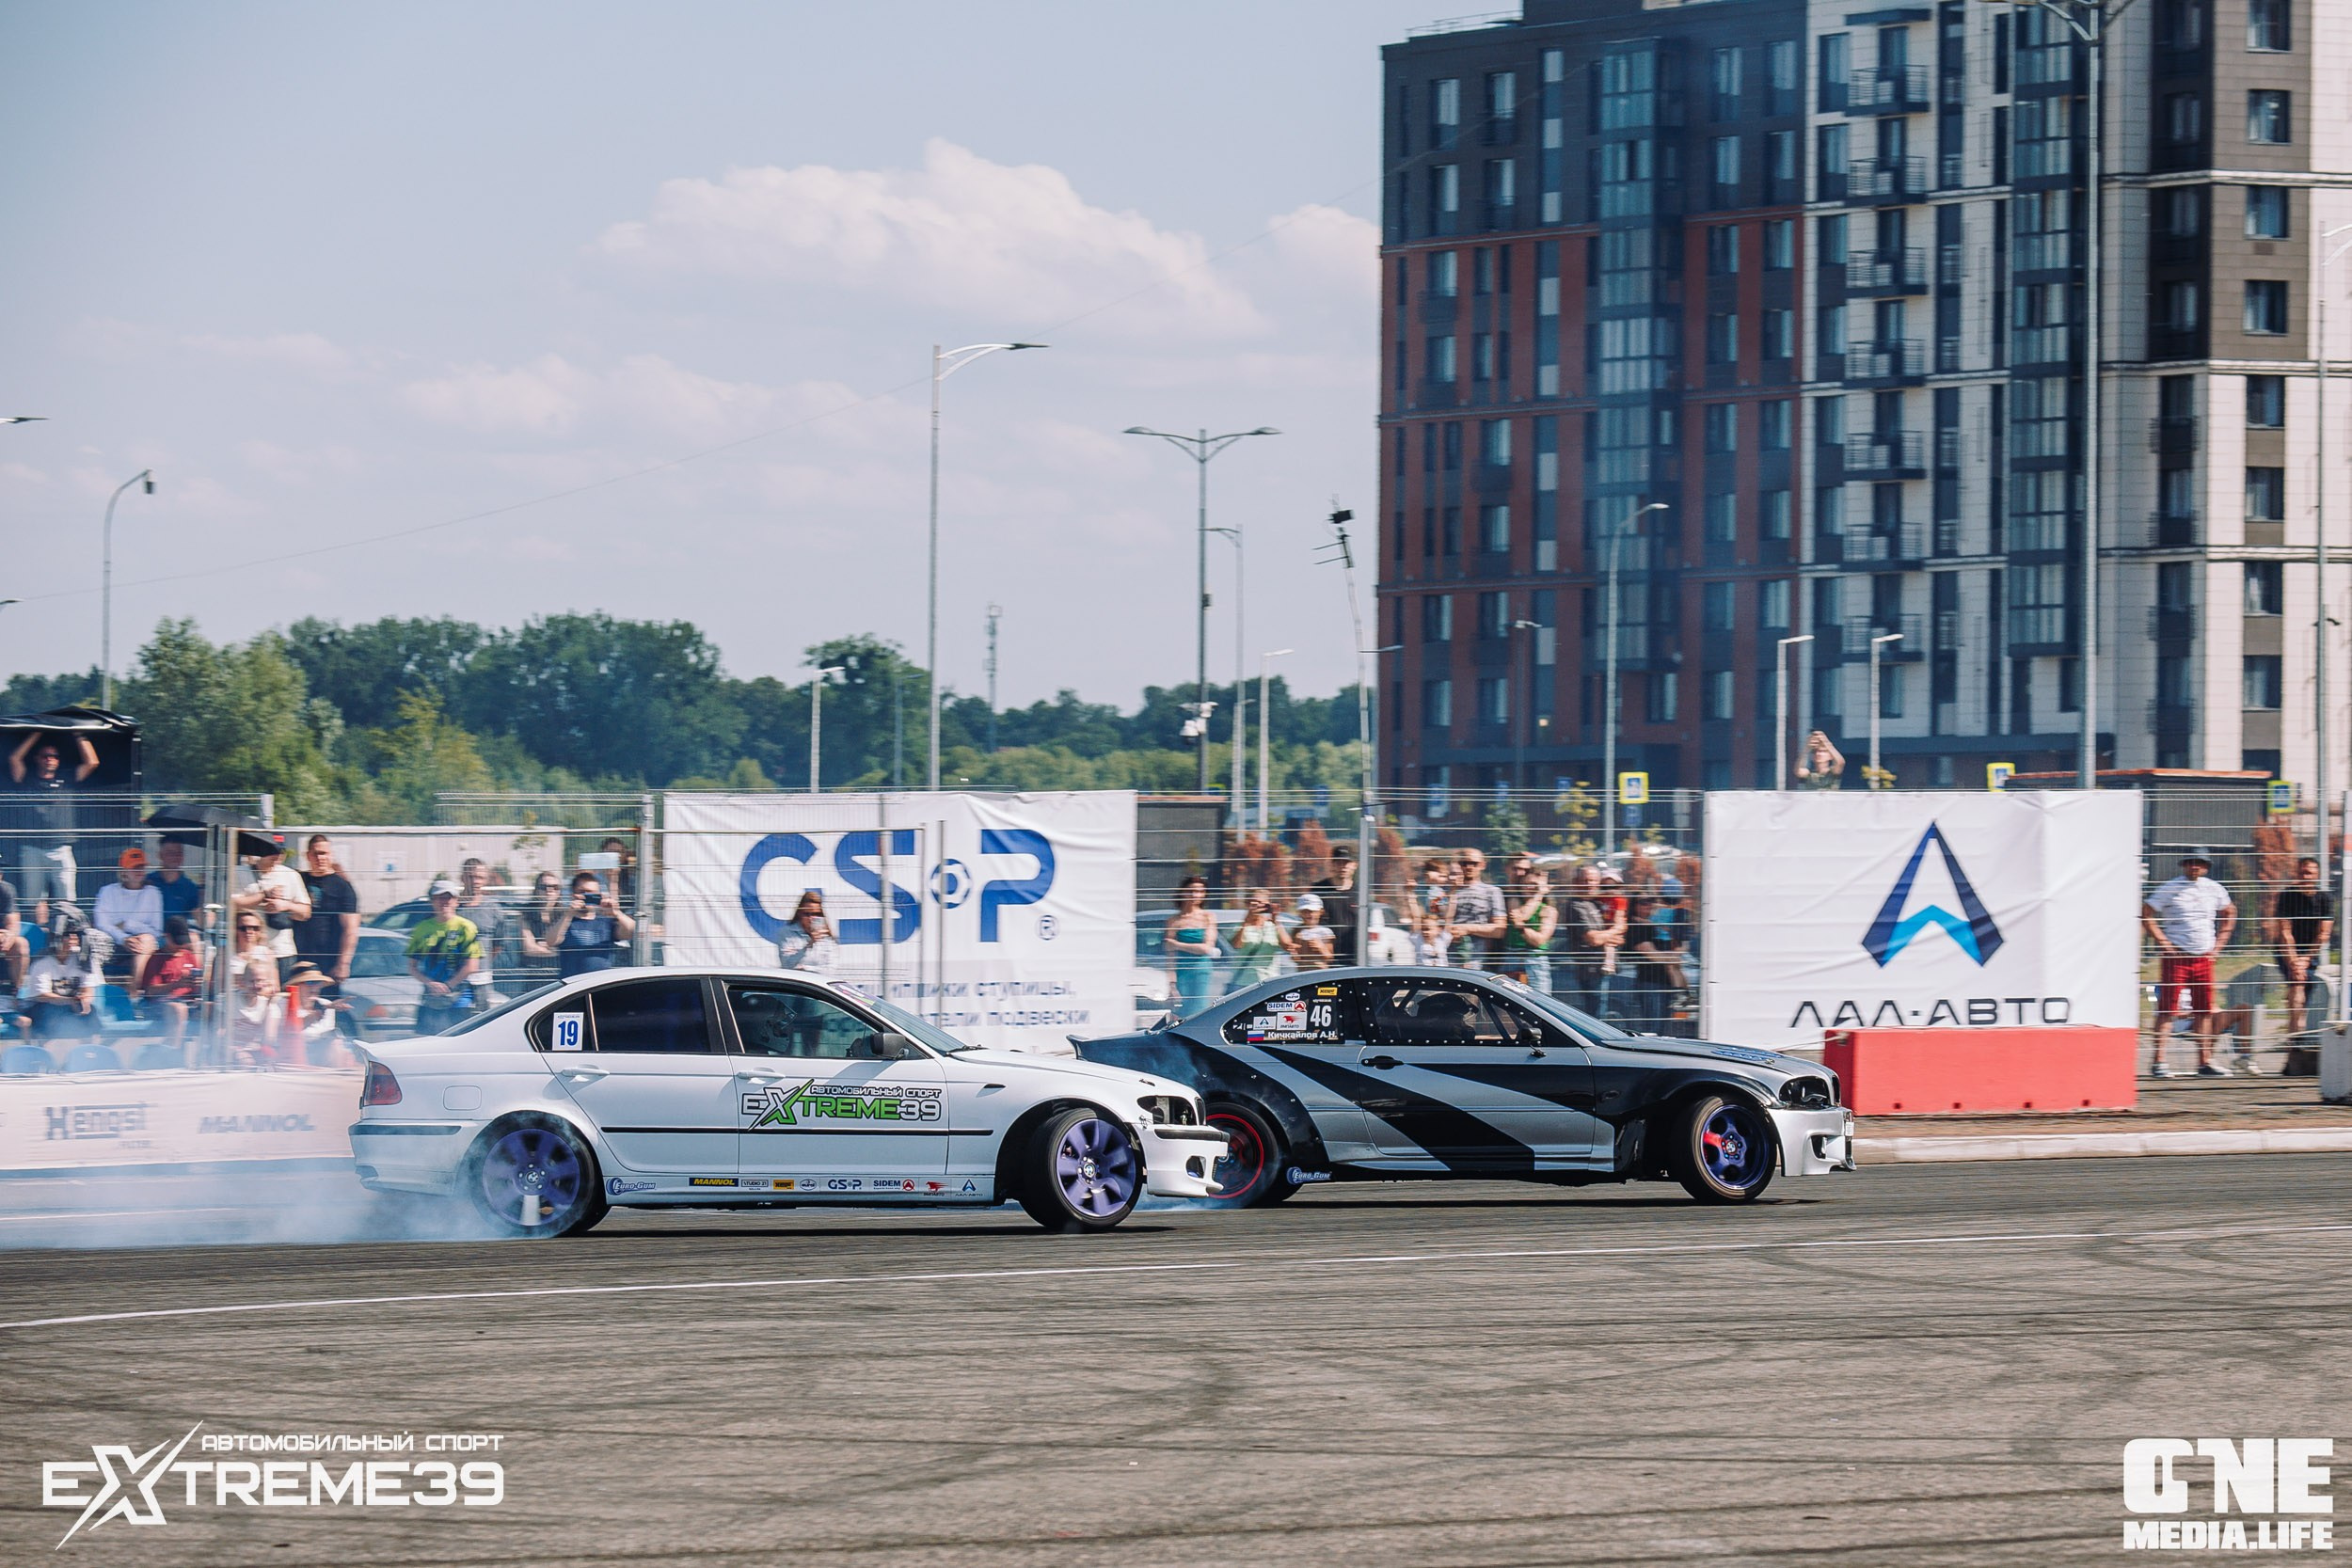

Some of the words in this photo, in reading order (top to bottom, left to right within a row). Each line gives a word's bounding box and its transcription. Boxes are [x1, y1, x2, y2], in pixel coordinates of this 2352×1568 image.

[1310, 1005, 1332, 1027] 46
[558, 1021, 579, 1046] 19
[1319, 1030, 1338, 1039] А.Н.
[810, 1085, 903, 1098] АВТОМОБИЛЬНЫЙ
[905, 1087, 942, 1099] СПОРТ
[741, 1079, 942, 1130] EXTREME39
[693, 1178, 736, 1186] MANNOL
